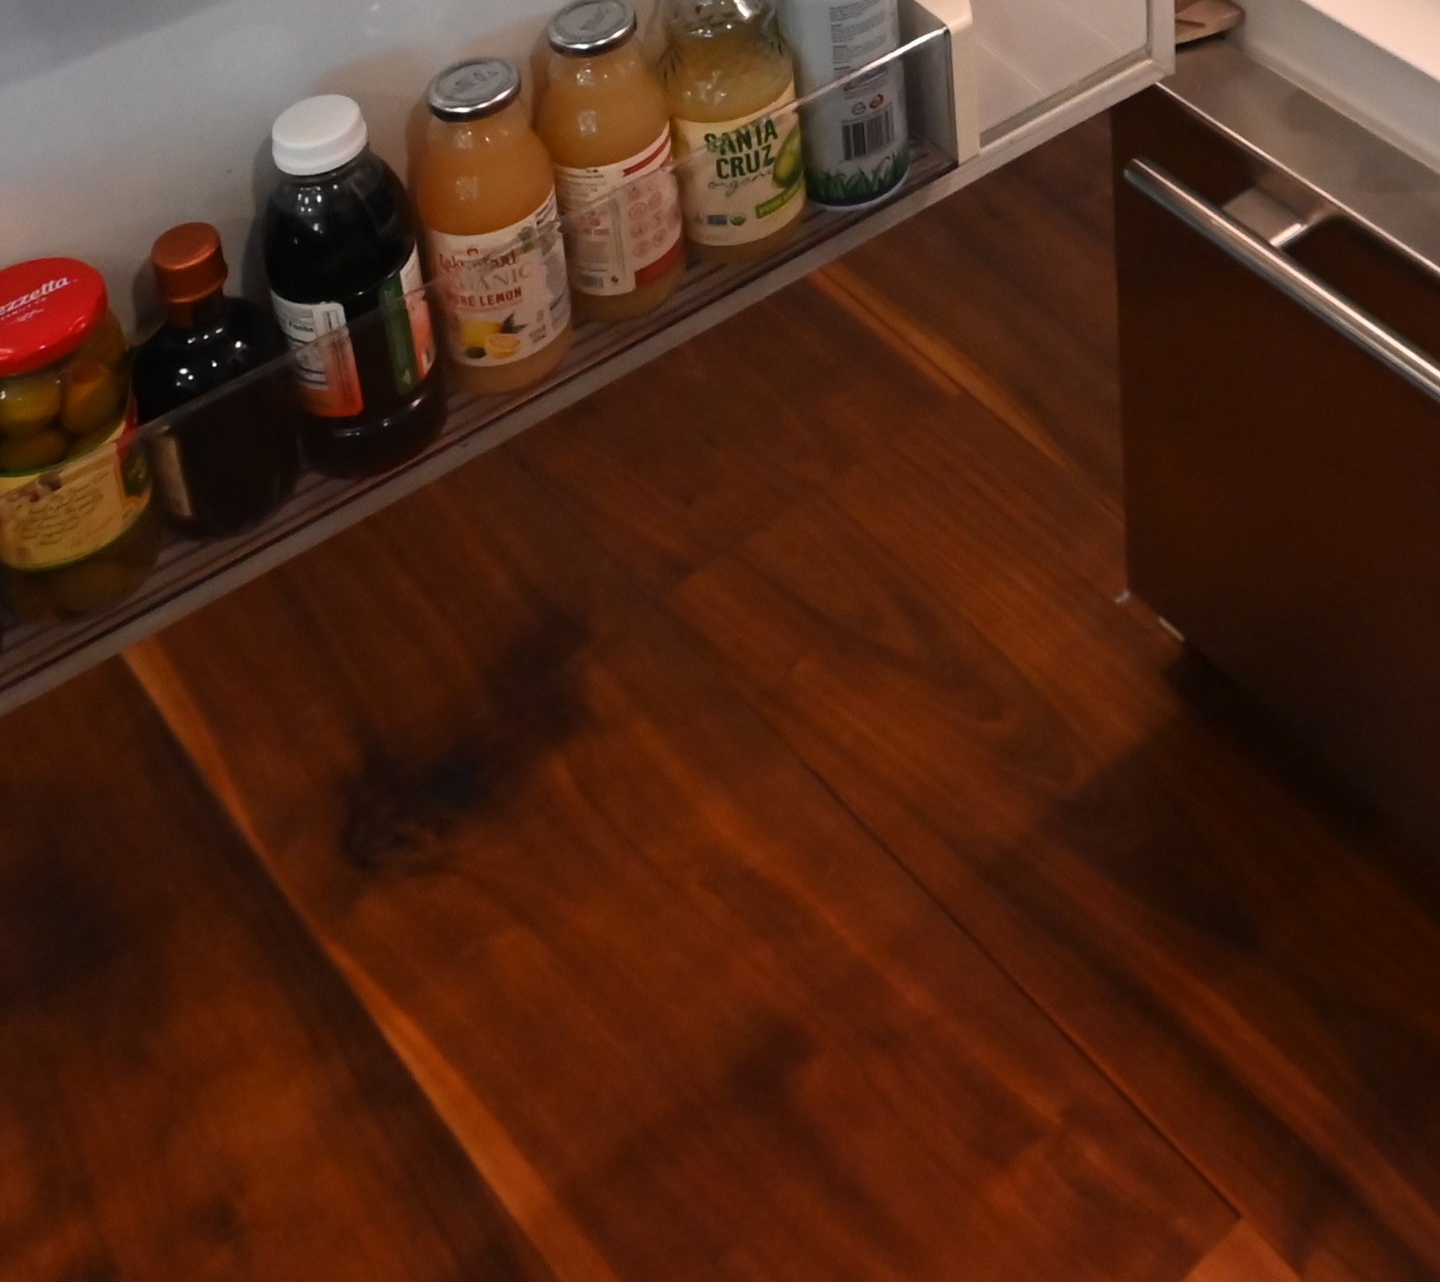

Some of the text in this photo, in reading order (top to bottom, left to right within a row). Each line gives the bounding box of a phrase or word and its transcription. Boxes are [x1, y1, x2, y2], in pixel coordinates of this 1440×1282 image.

[704, 119, 778, 157] SANTA
[716, 144, 776, 180] CRUZ
[479, 287, 523, 307] LEMON
